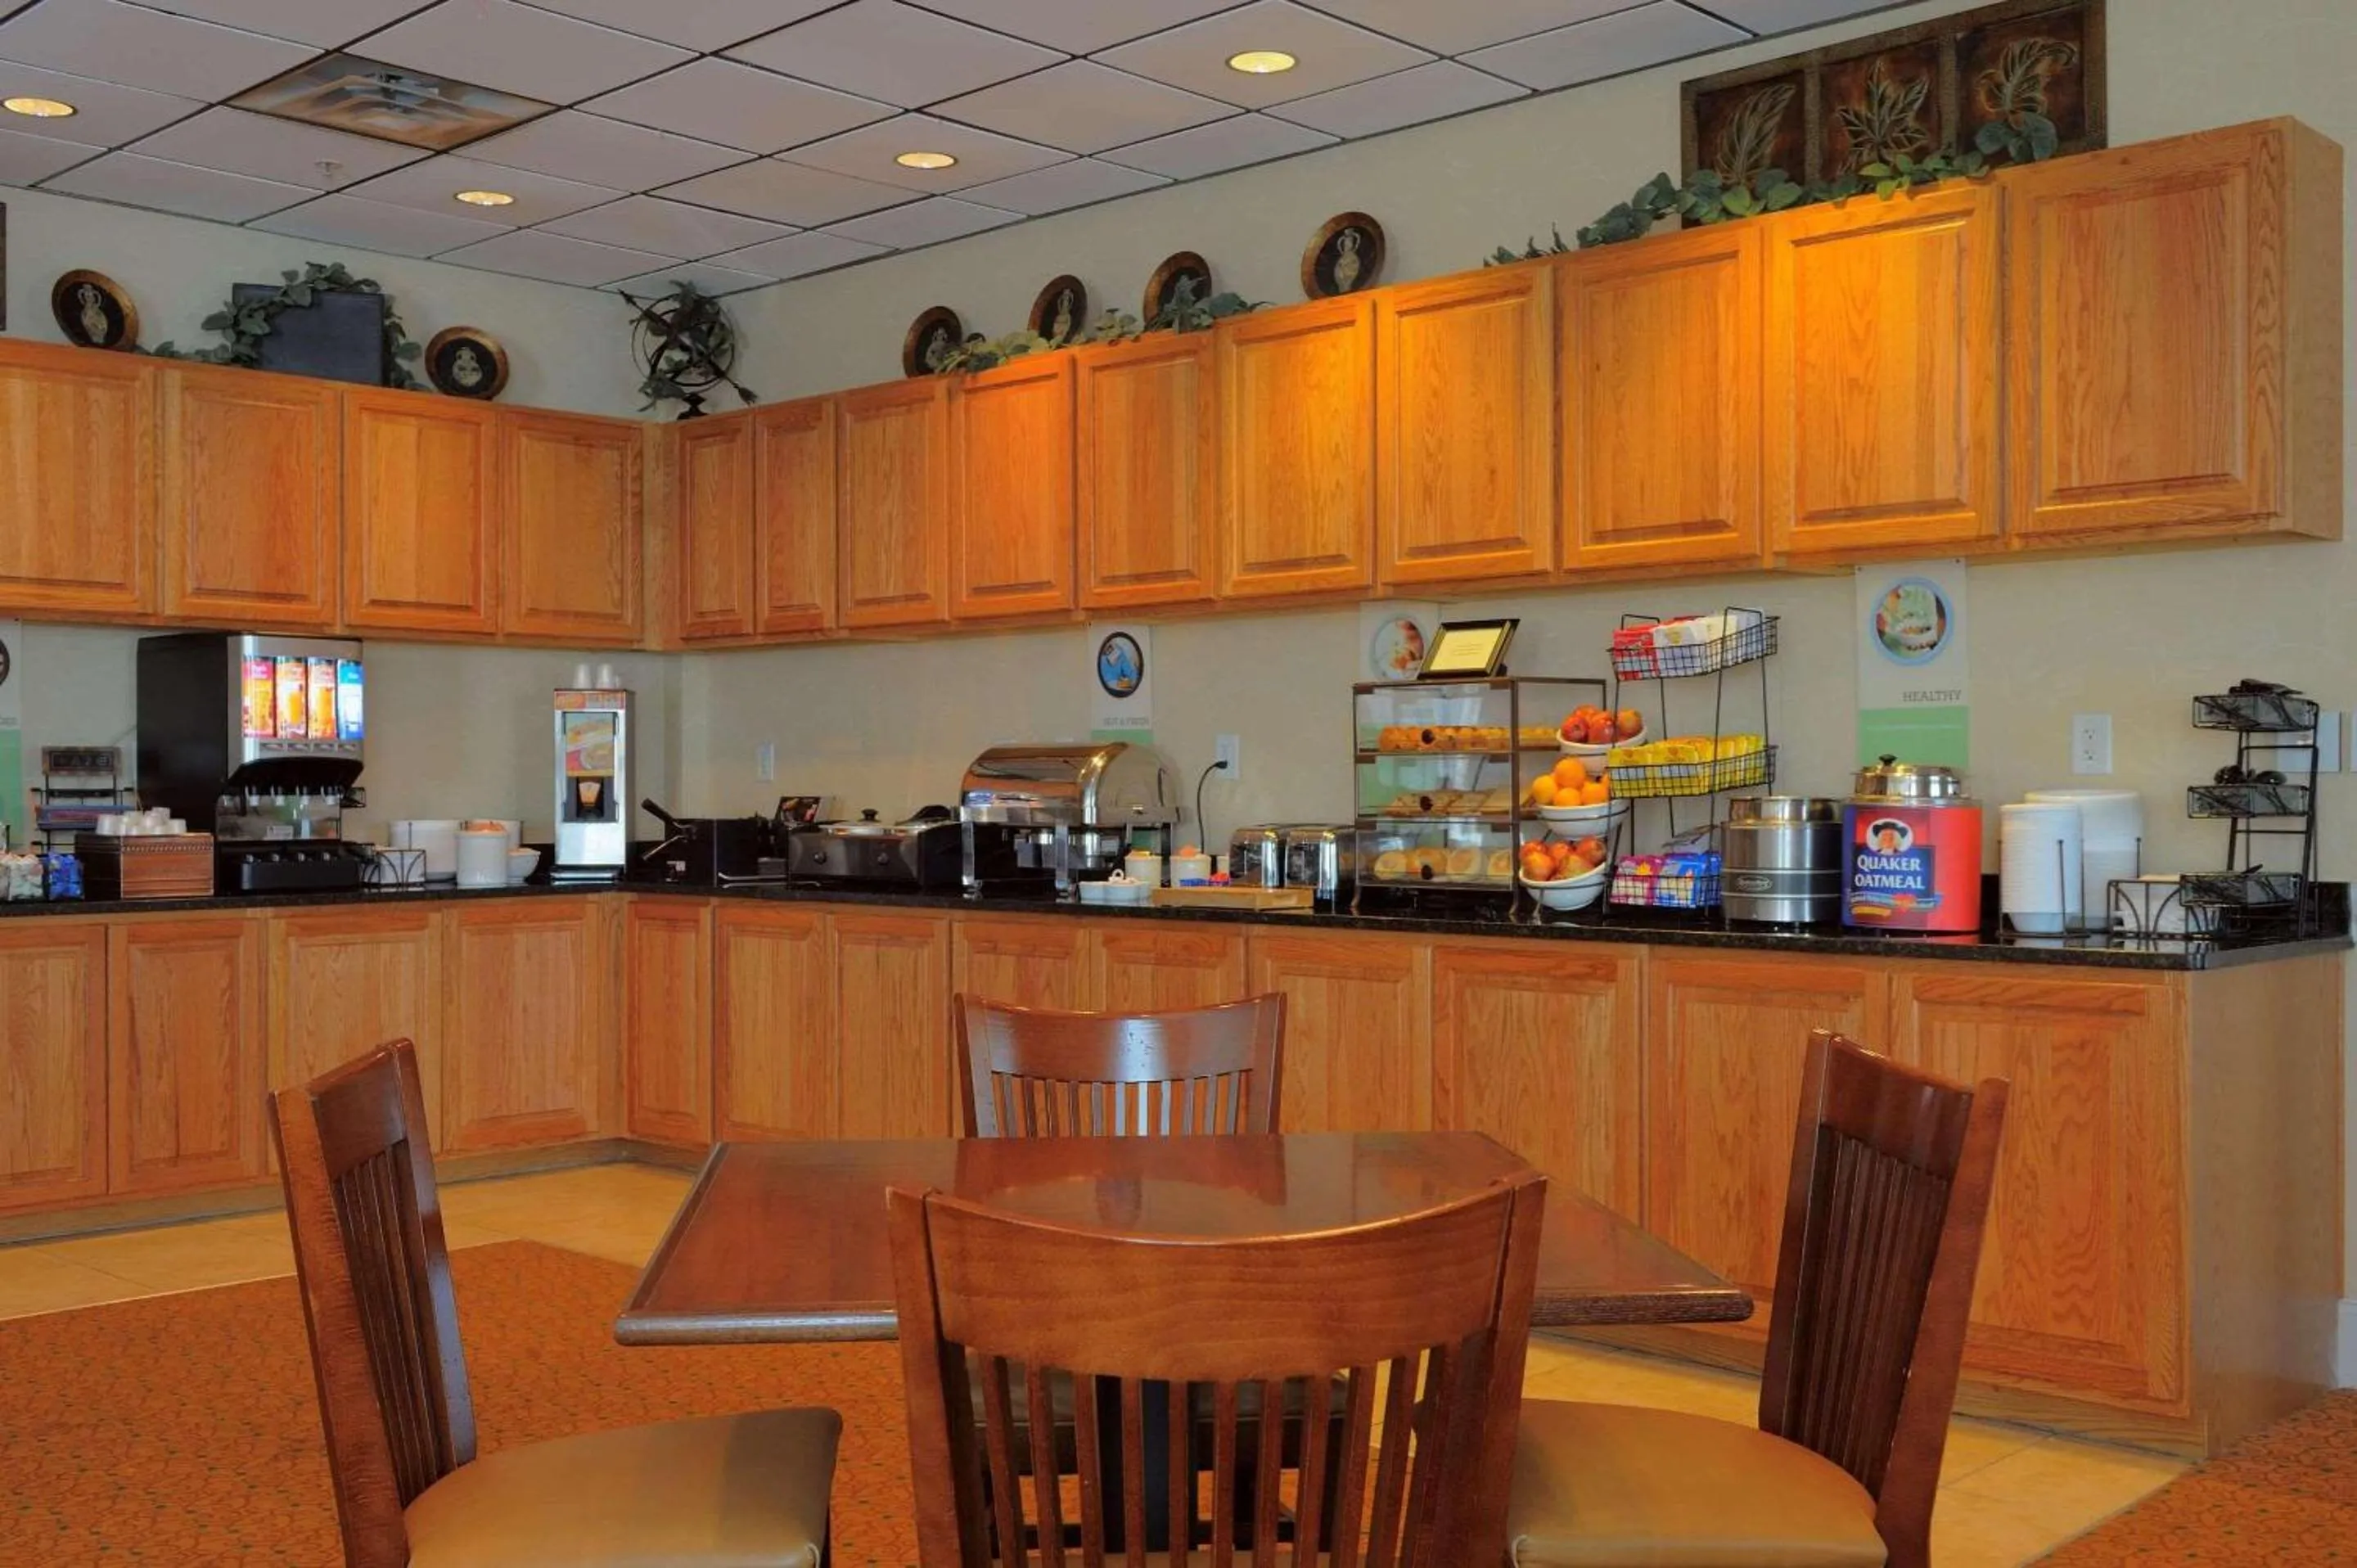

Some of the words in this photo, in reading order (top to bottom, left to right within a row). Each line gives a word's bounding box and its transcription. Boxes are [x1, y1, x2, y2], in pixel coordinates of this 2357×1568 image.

[1902, 689, 1962, 701] HEALTHY
[1857, 854, 1922, 872] QUAKER
[1855, 873, 1926, 890] OATMEAL
